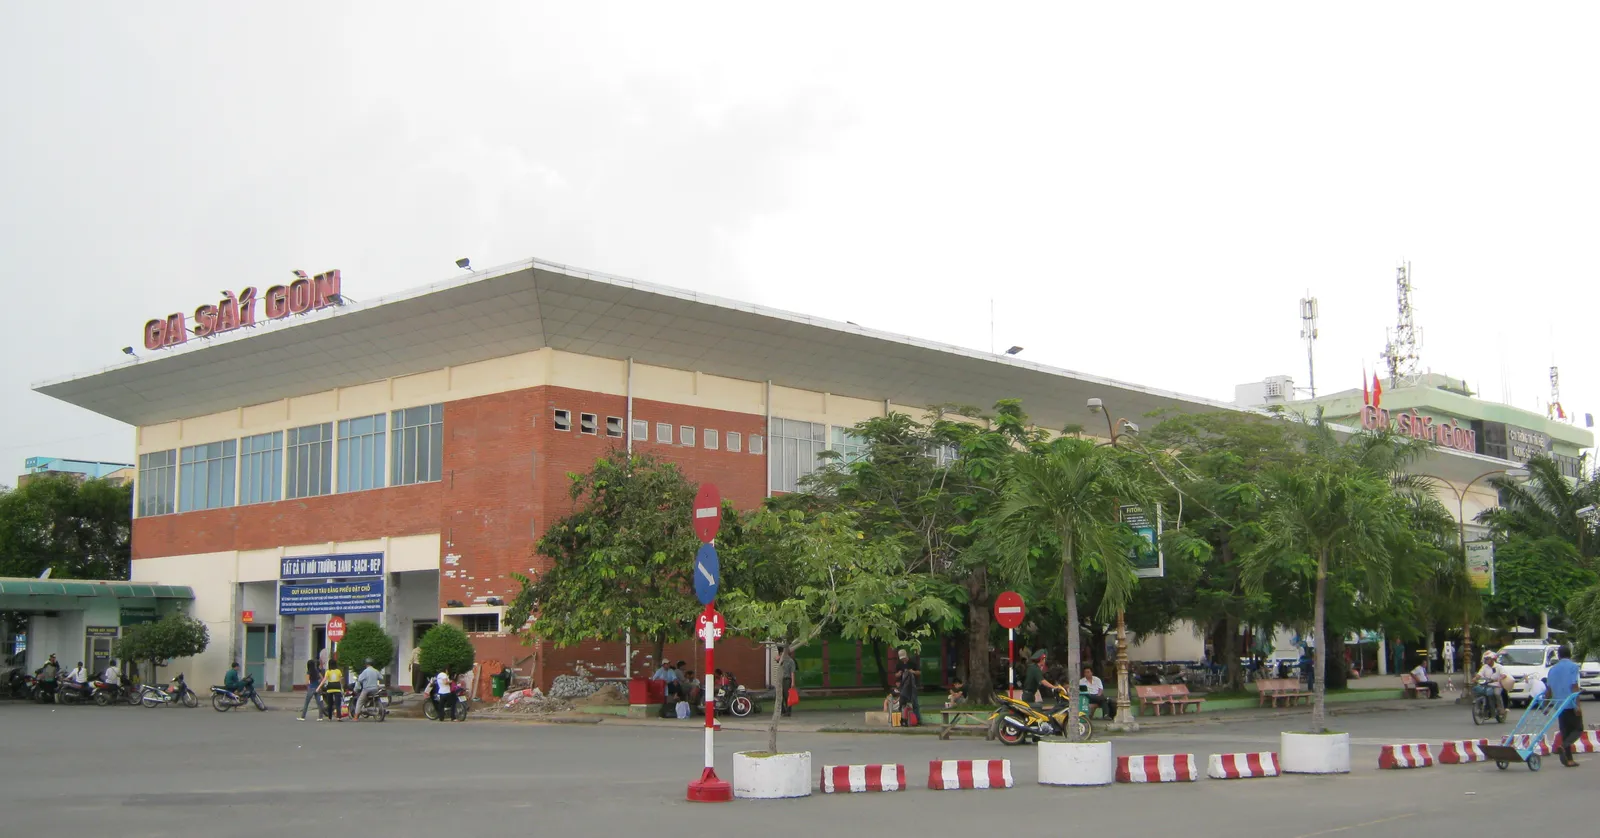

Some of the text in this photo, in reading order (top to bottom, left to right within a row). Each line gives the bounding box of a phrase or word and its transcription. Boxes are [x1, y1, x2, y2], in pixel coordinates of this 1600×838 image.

[144, 312, 187, 350] GA
[265, 269, 341, 319] GÒN
[1360, 405, 1391, 432] GA
[1437, 418, 1476, 453] GÒN
[283, 560, 292, 575] TẤT
[292, 559, 299, 575] CẢ
[300, 560, 306, 574] VÌ
[306, 559, 317, 574] MÔI
[317, 558, 336, 573] TRƯỜNG
[329, 619, 343, 628] CẤM
[700, 615, 718, 624] CM
